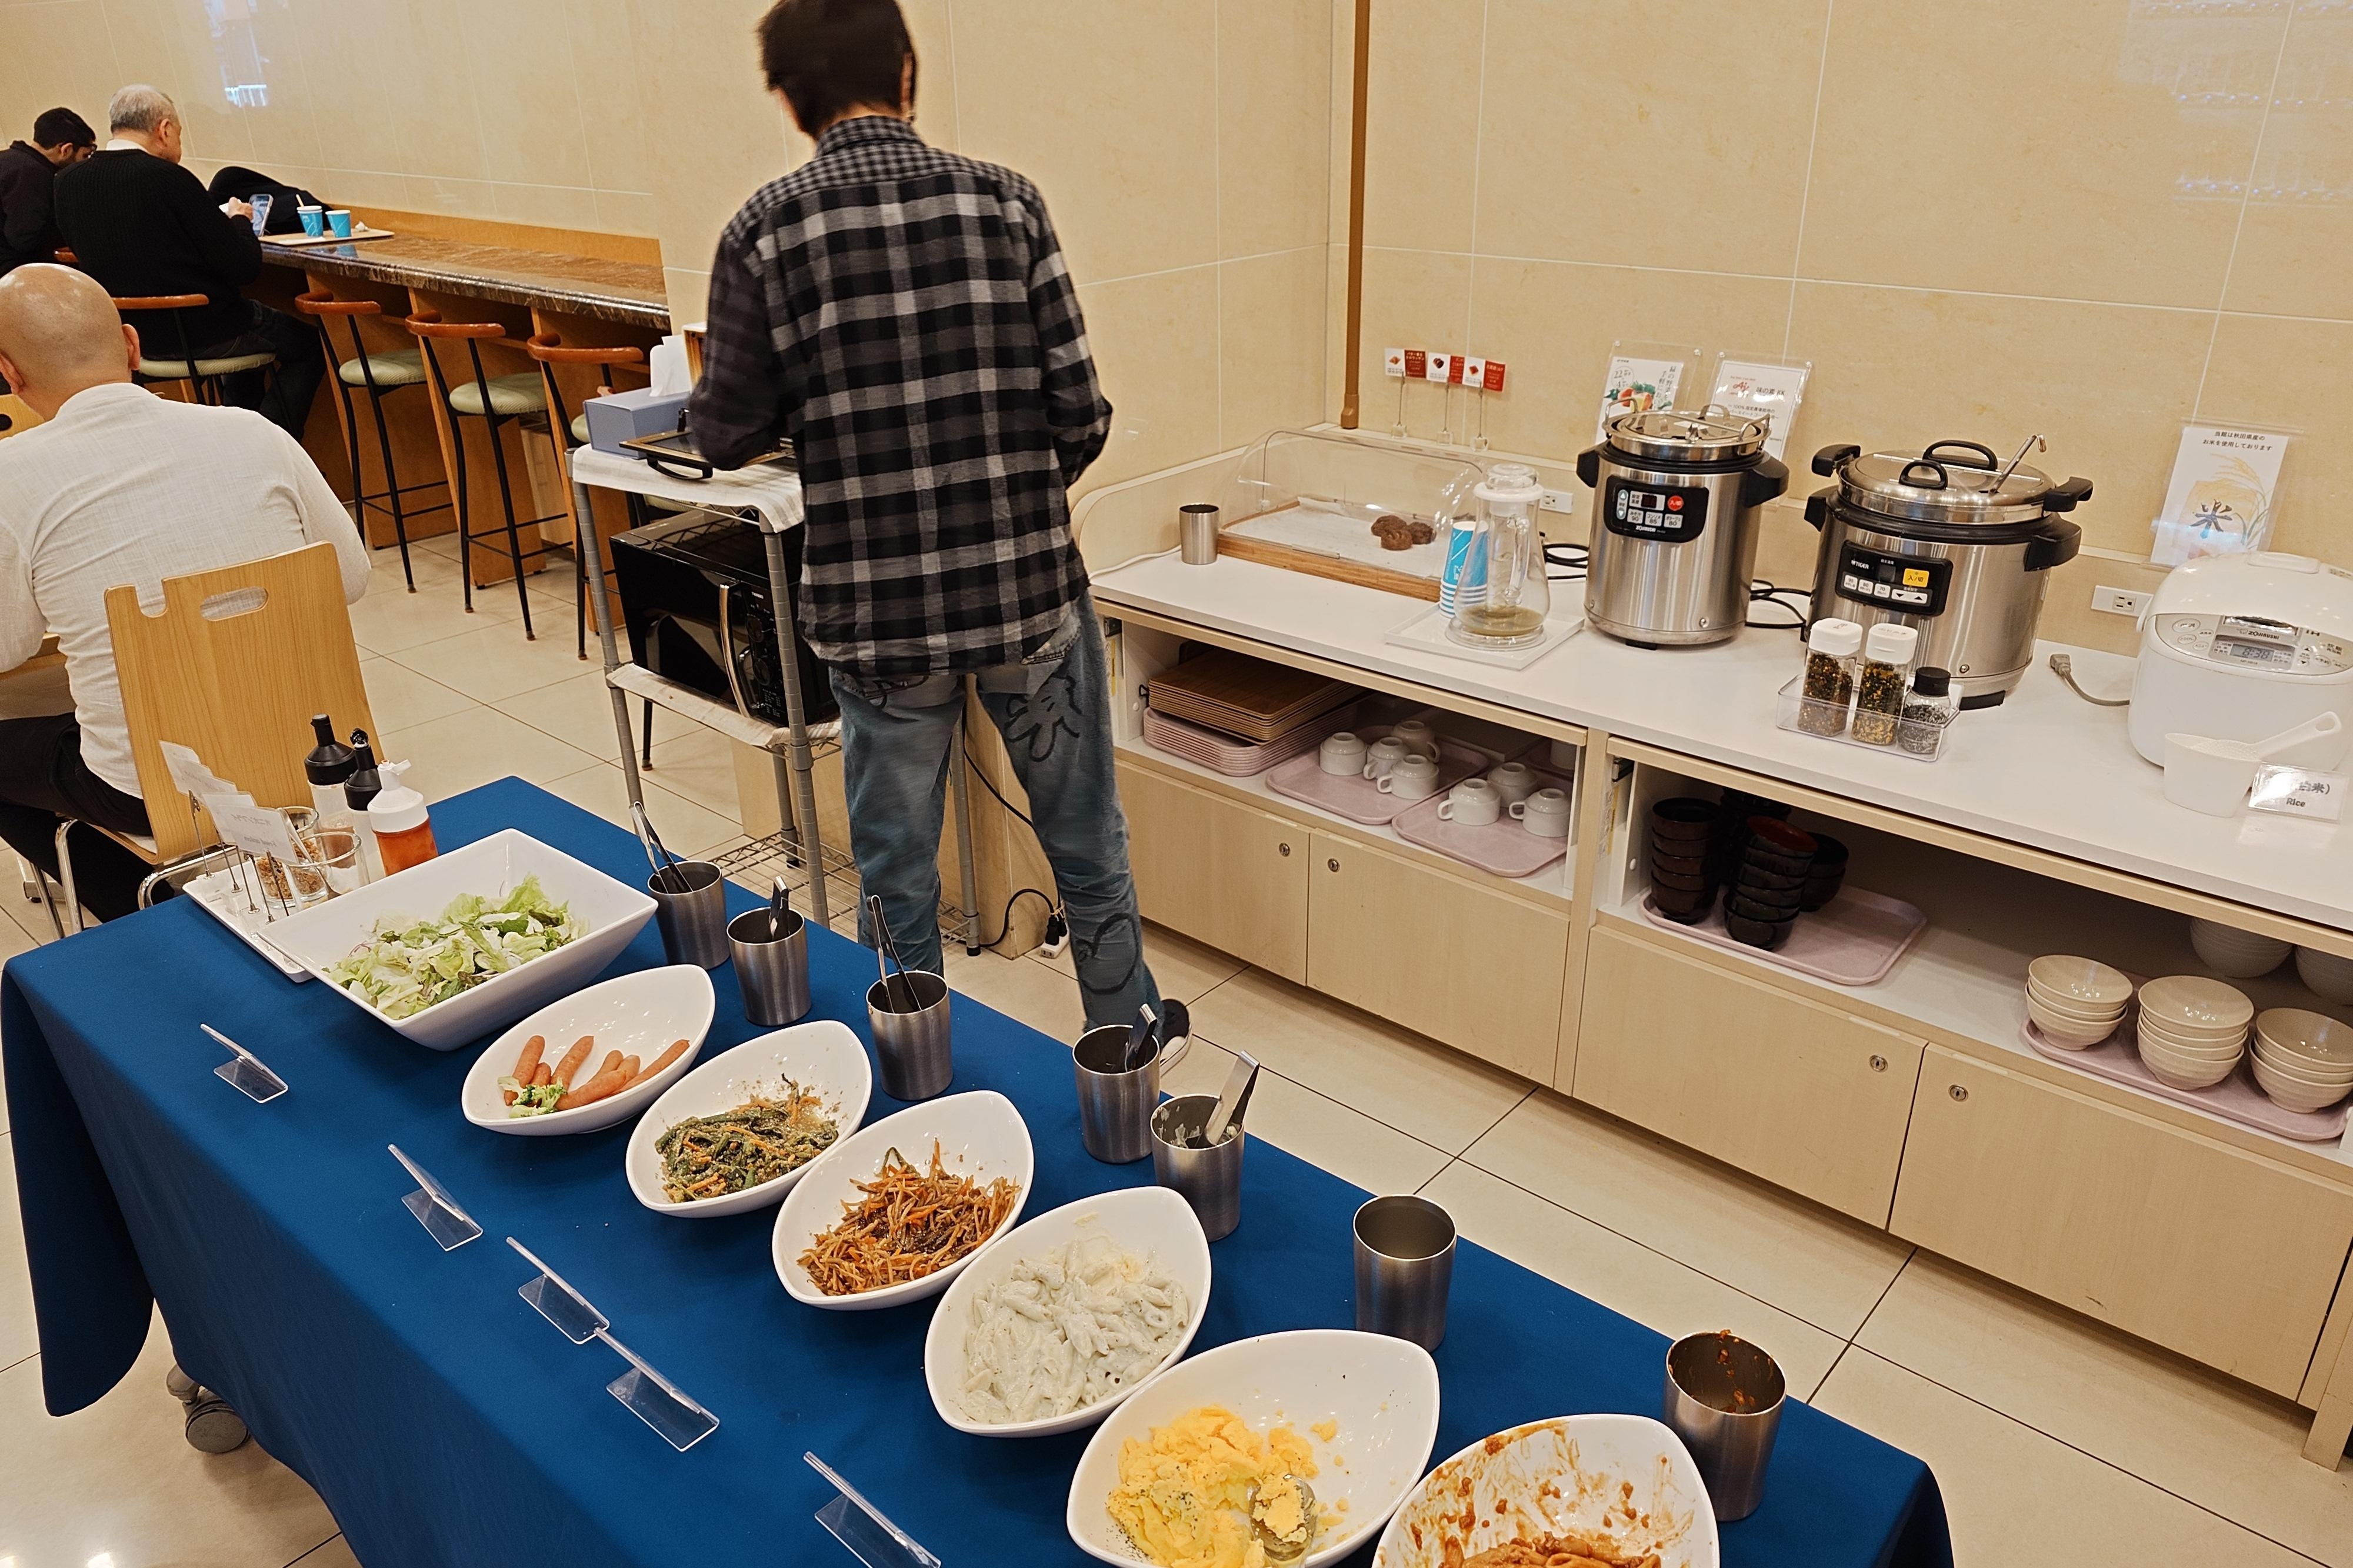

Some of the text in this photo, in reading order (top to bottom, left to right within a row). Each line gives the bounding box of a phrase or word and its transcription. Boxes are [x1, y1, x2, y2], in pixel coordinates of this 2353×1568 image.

[2214, 431, 2266, 441] 当館は秋田県産の
[2203, 439, 2273, 451] お米を使用しております
[2190, 498, 2233, 539] 米
[1855, 561, 1869, 570] TIGER
[1908, 575, 1924, 583] 入/切
[2248, 630, 2279, 640] ZOJIRUSHI
[2297, 780, 2331, 795] 白米)
[2286, 798, 2306, 808] Rice
